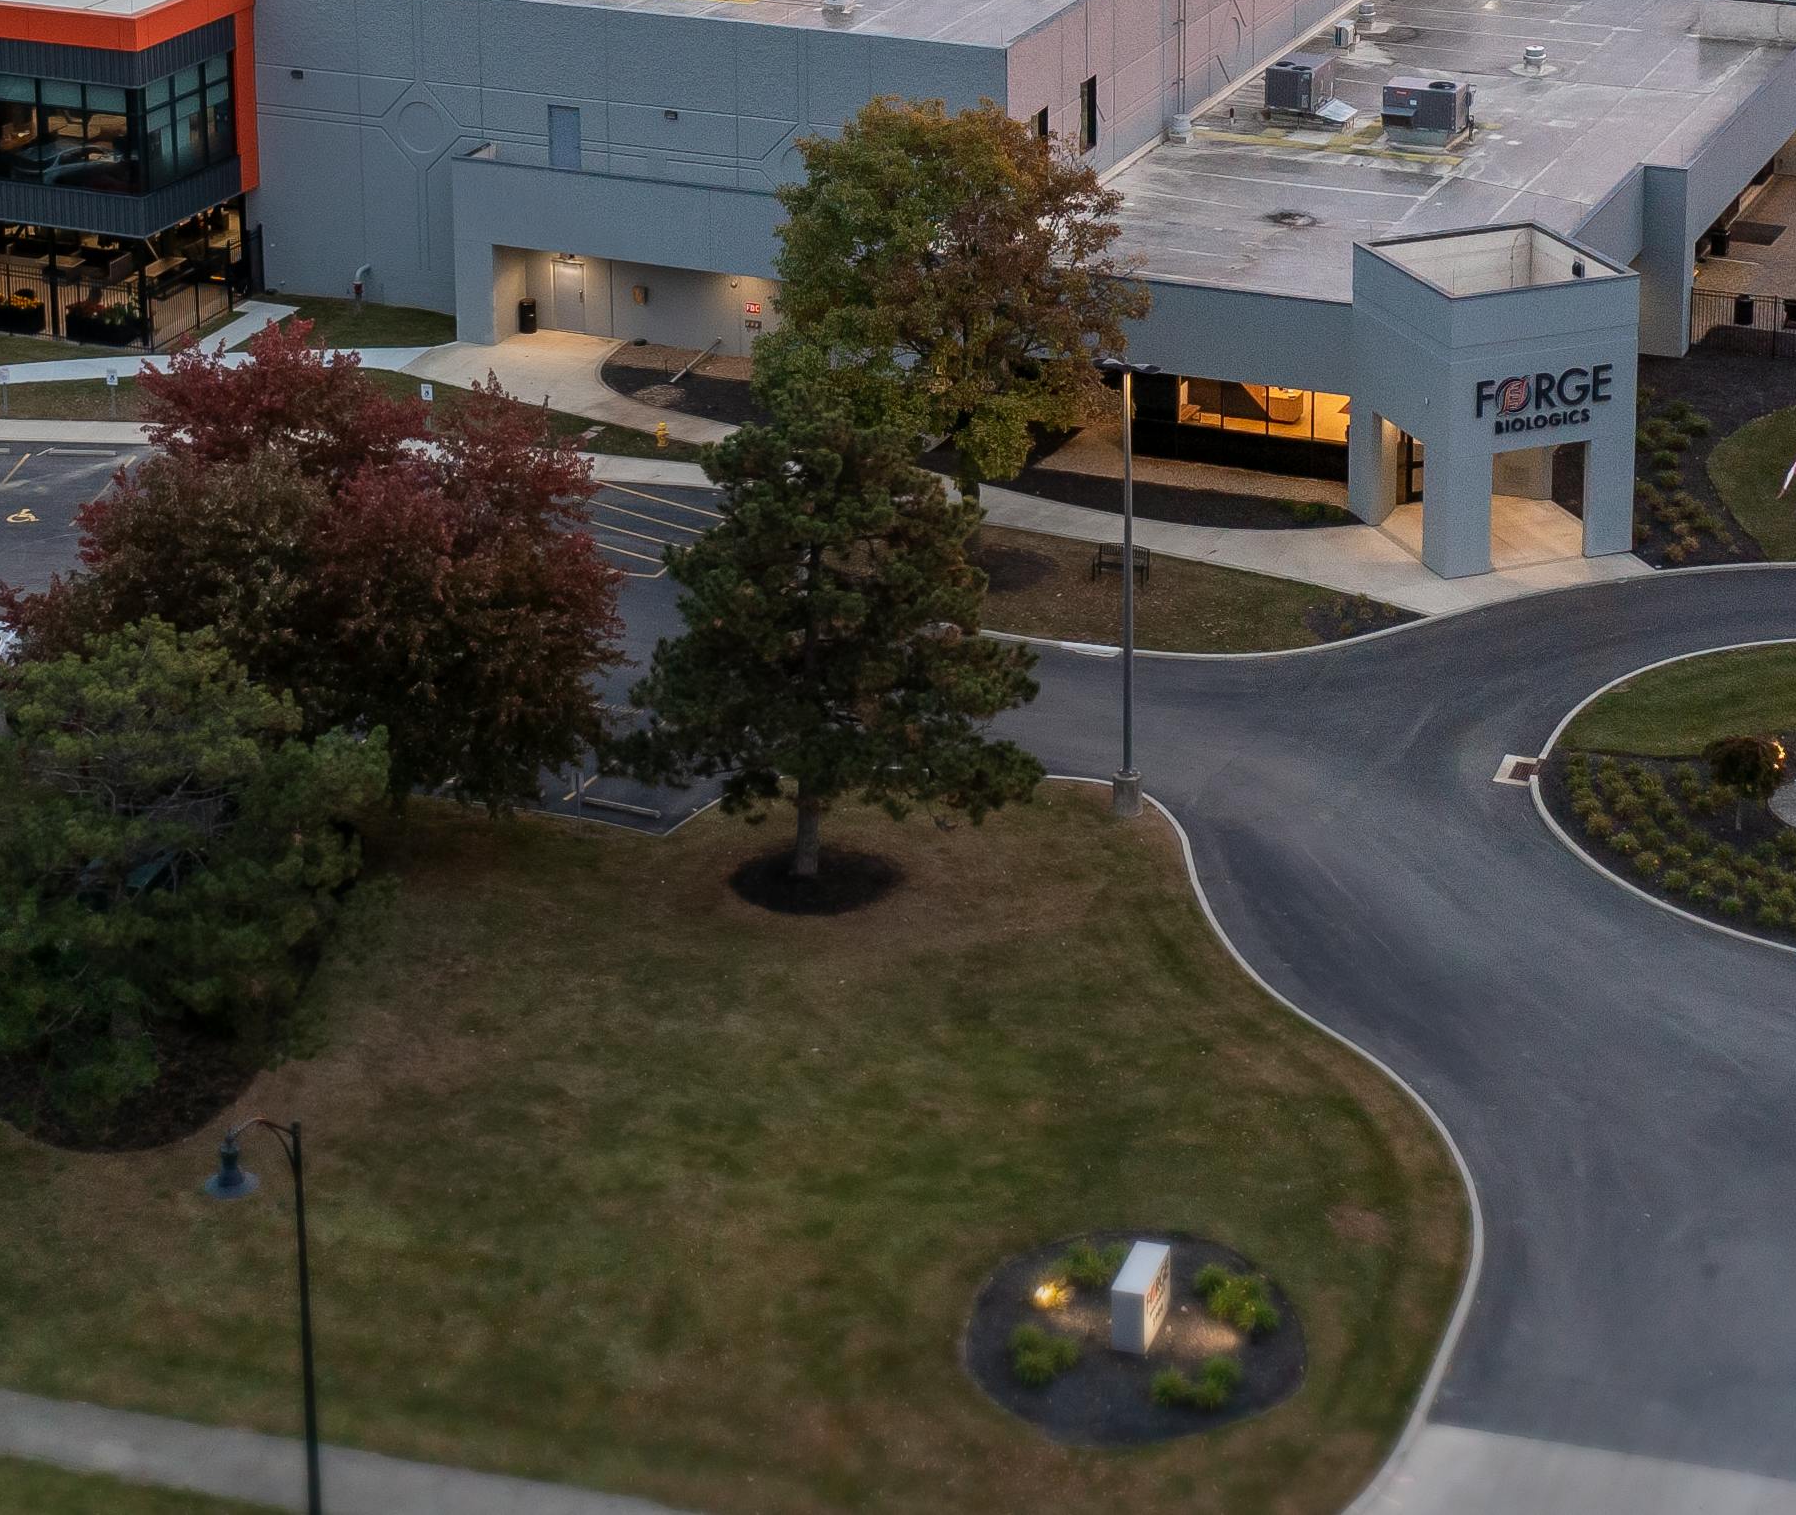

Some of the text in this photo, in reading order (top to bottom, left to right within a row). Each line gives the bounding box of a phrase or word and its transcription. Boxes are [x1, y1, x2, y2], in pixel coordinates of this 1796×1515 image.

[747, 304, 760, 312] FDC
[1476, 363, 1613, 418] FORGE
[1494, 408, 1591, 435] BIOLOGICS
